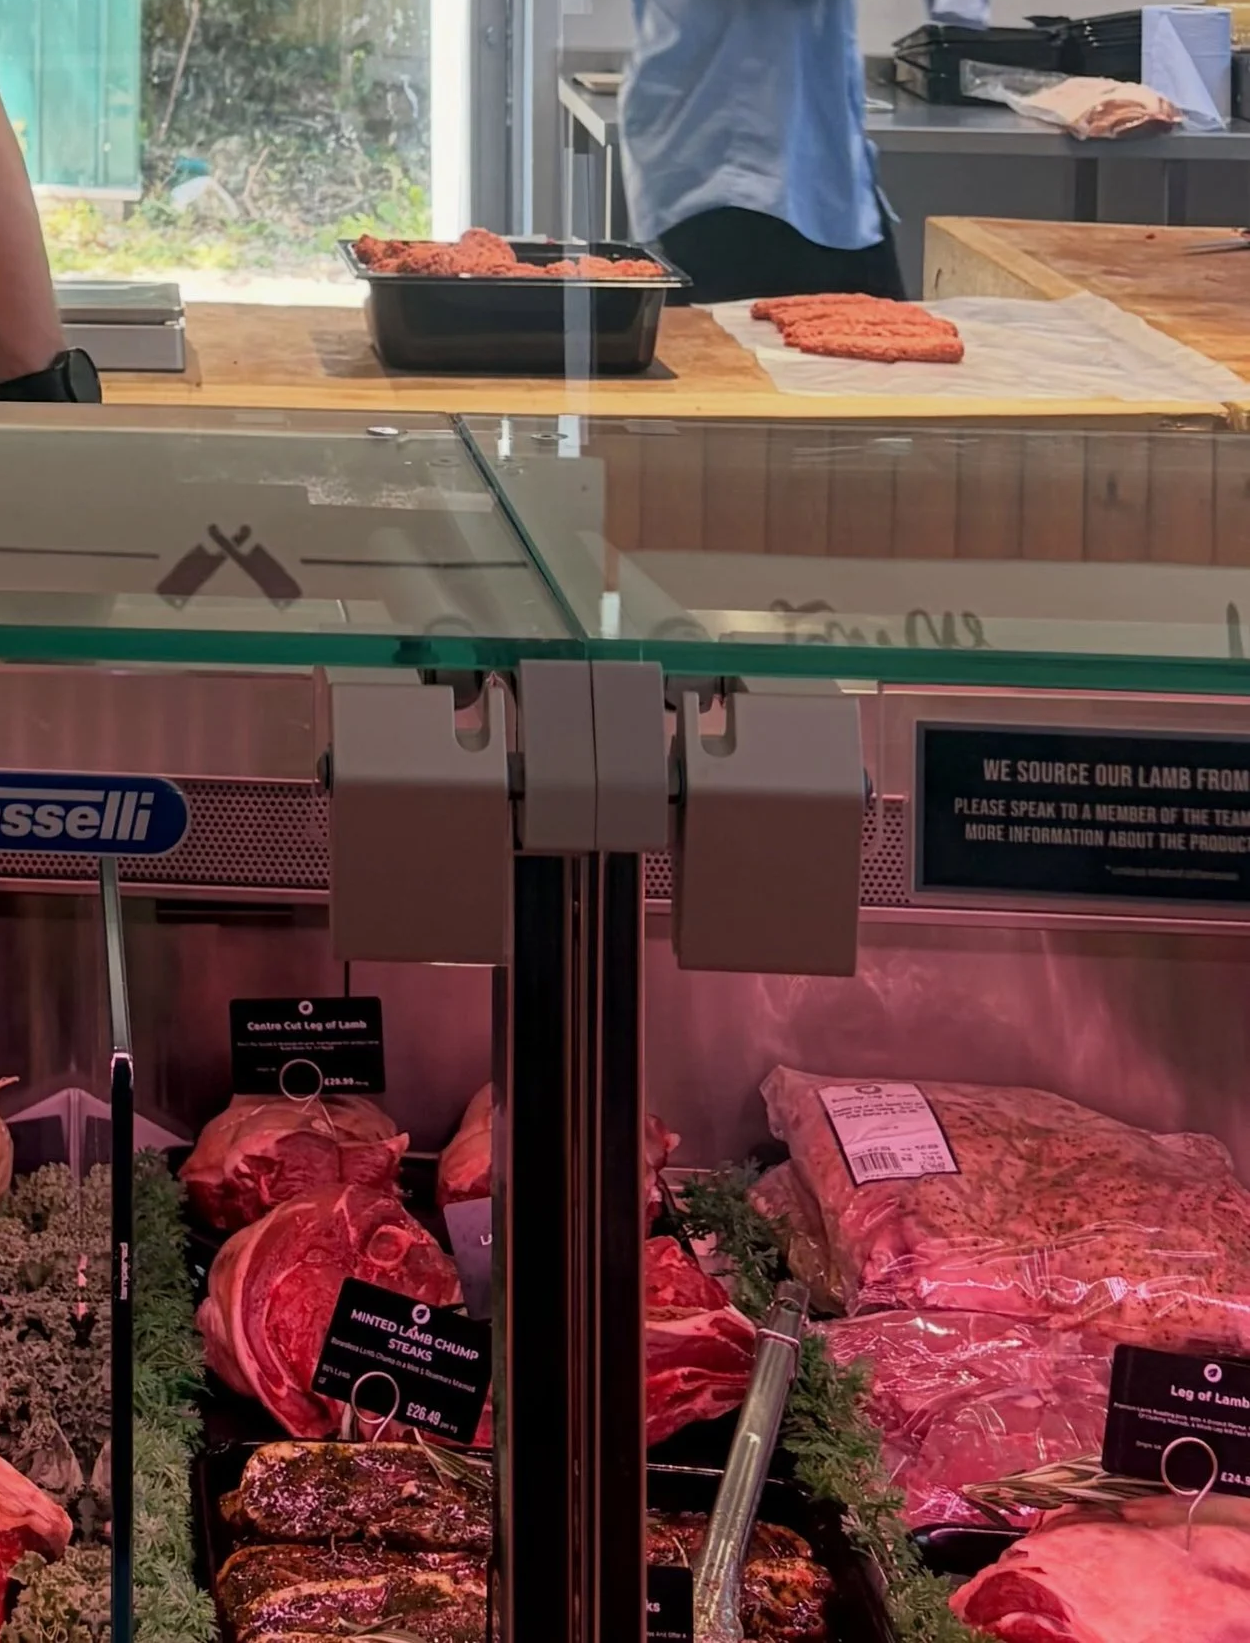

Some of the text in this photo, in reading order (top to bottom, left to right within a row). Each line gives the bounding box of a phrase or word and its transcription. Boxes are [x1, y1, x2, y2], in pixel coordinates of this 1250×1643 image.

[983, 759, 1249, 792] WE SOURCE OUR LAMB FROM
[954, 797, 1006, 816] PLEASE
[1010, 800, 1055, 819] SPEAK
[1060, 802, 1077, 819] TO
[1081, 803, 1093, 820] A
[1099, 804, 1157, 824] MEMBER
[1160, 807, 1178, 824] OF
[1183, 808, 1209, 826] THE
[965, 823, 1004, 842] MORE
[1009, 825, 1103, 846] INFORMATION
[1108, 829, 1154, 849] ABOUT
[1159, 831, 1186, 851] THE
[284, 1021, 302, 1030] Cut
[304, 1021, 323, 1032] Leg
[325, 1020, 337, 1030] of
[338, 1019, 367, 1030] Lamb
[351, 1308, 479, 1361] MINTED LAMB CHUMP
[388, 1338, 433, 1362] STEAKS
[1170, 1384, 1250, 1409] Leg of Lamb
[406, 1402, 441, 1426] £26.49
